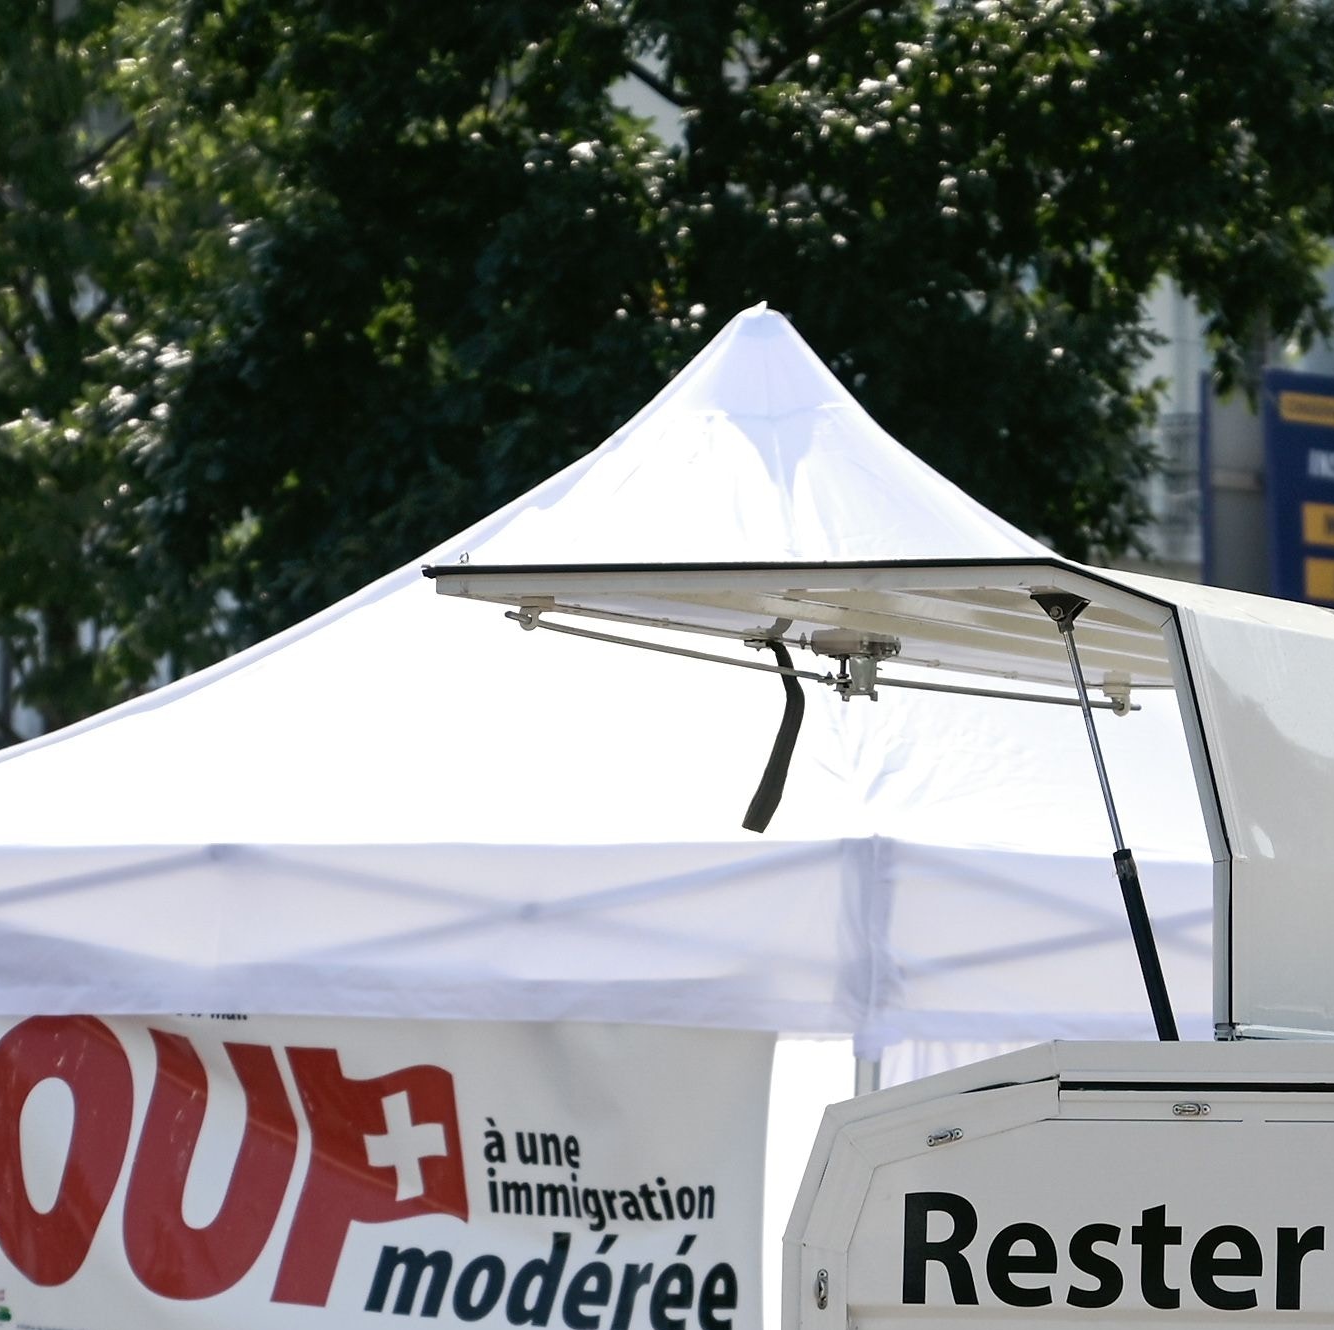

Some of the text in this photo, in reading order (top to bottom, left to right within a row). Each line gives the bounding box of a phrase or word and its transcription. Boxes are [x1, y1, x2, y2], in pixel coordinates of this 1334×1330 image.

[484, 1117, 581, 1169] à une
[487, 1168, 715, 1231] immigration
[902, 1191, 1325, 1311] Rester
